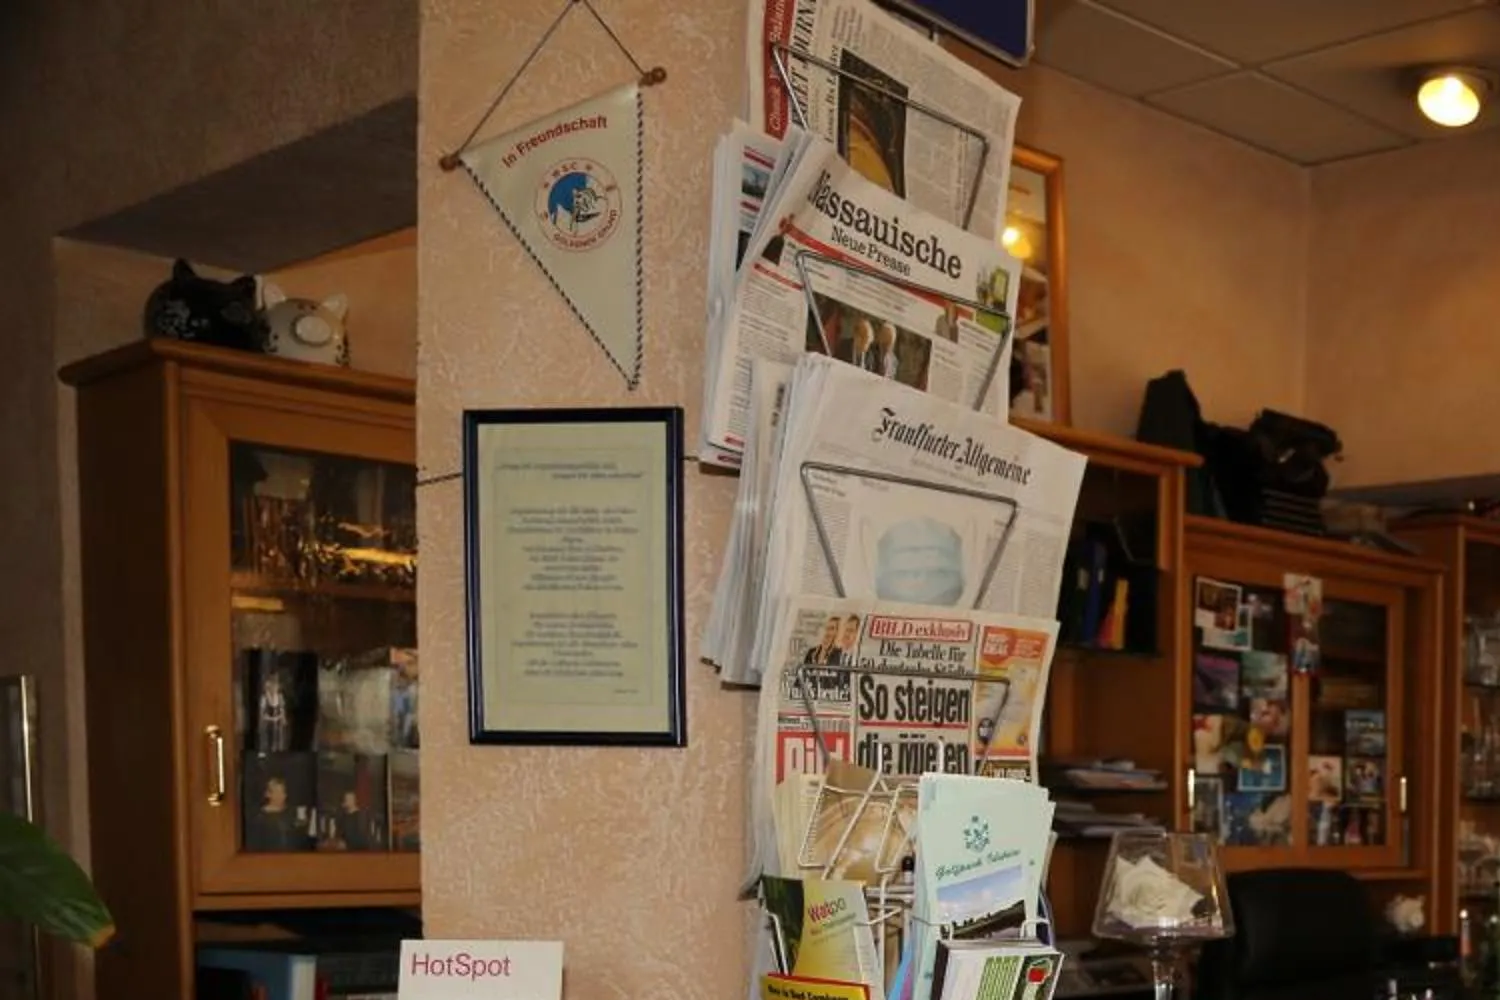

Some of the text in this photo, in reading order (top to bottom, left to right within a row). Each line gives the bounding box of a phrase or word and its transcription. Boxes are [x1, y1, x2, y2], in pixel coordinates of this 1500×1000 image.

[501, 114, 607, 168] In Freundschaft
[807, 168, 962, 279] Nassauische
[831, 225, 911, 276] Neue Presse
[872, 407, 1031, 485] Frankfurter Allgemeine
[880, 640, 901, 657] Die
[906, 641, 946, 660] Tabelle
[948, 645, 967, 662] für
[860, 674, 889, 720] So
[894, 679, 970, 726] steigen
[857, 732, 892, 774] die
[898, 733, 969, 774] Mieen
[411, 953, 511, 982] HotSpot
